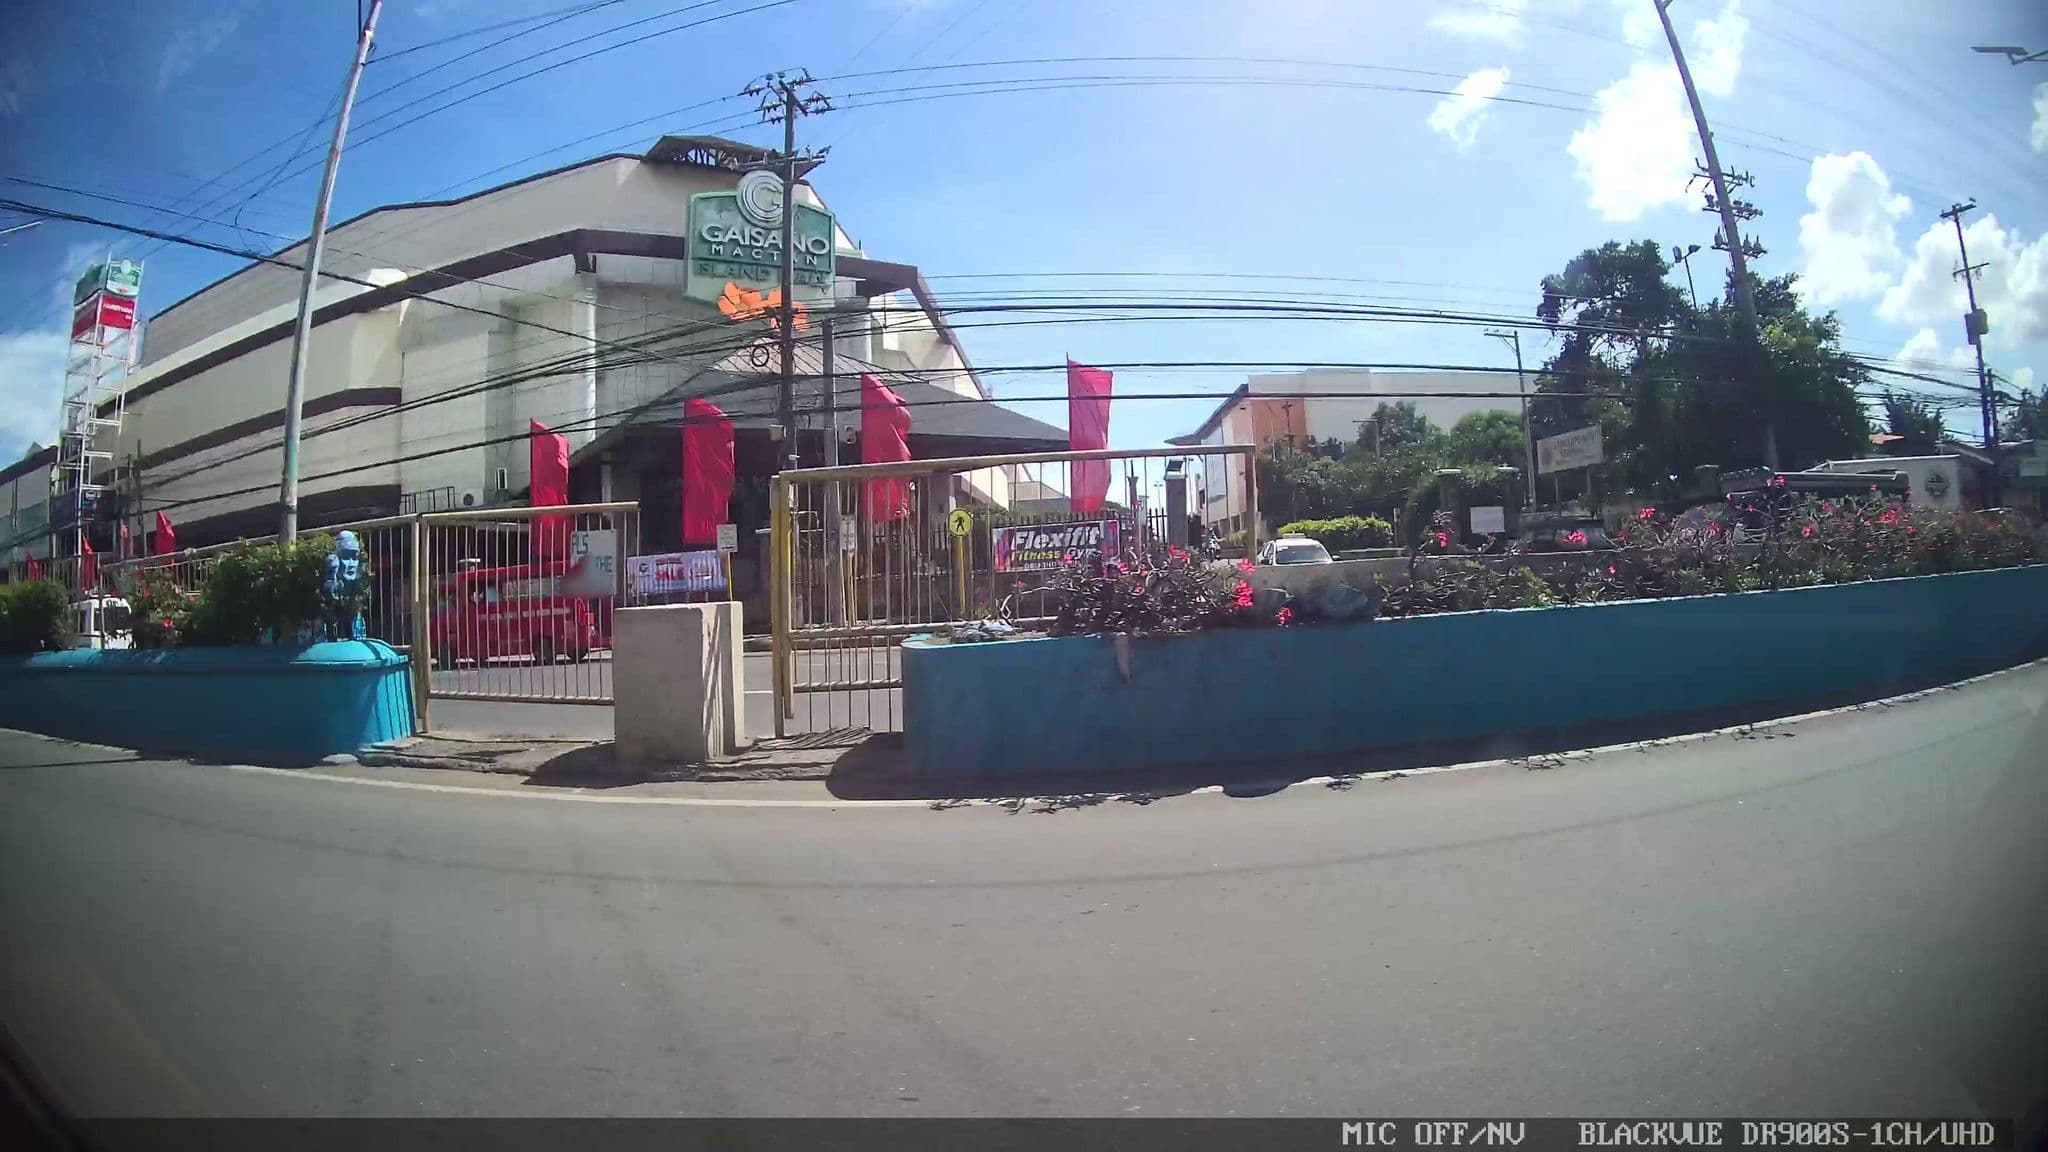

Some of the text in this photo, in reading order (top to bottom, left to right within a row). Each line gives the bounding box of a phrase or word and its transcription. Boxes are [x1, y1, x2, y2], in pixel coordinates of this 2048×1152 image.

[702, 224, 829, 255] GAISANO
[712, 245, 817, 265] MACTN
[1011, 526, 1100, 550] Flexifit
[1011, 550, 1061, 561] Fitness
